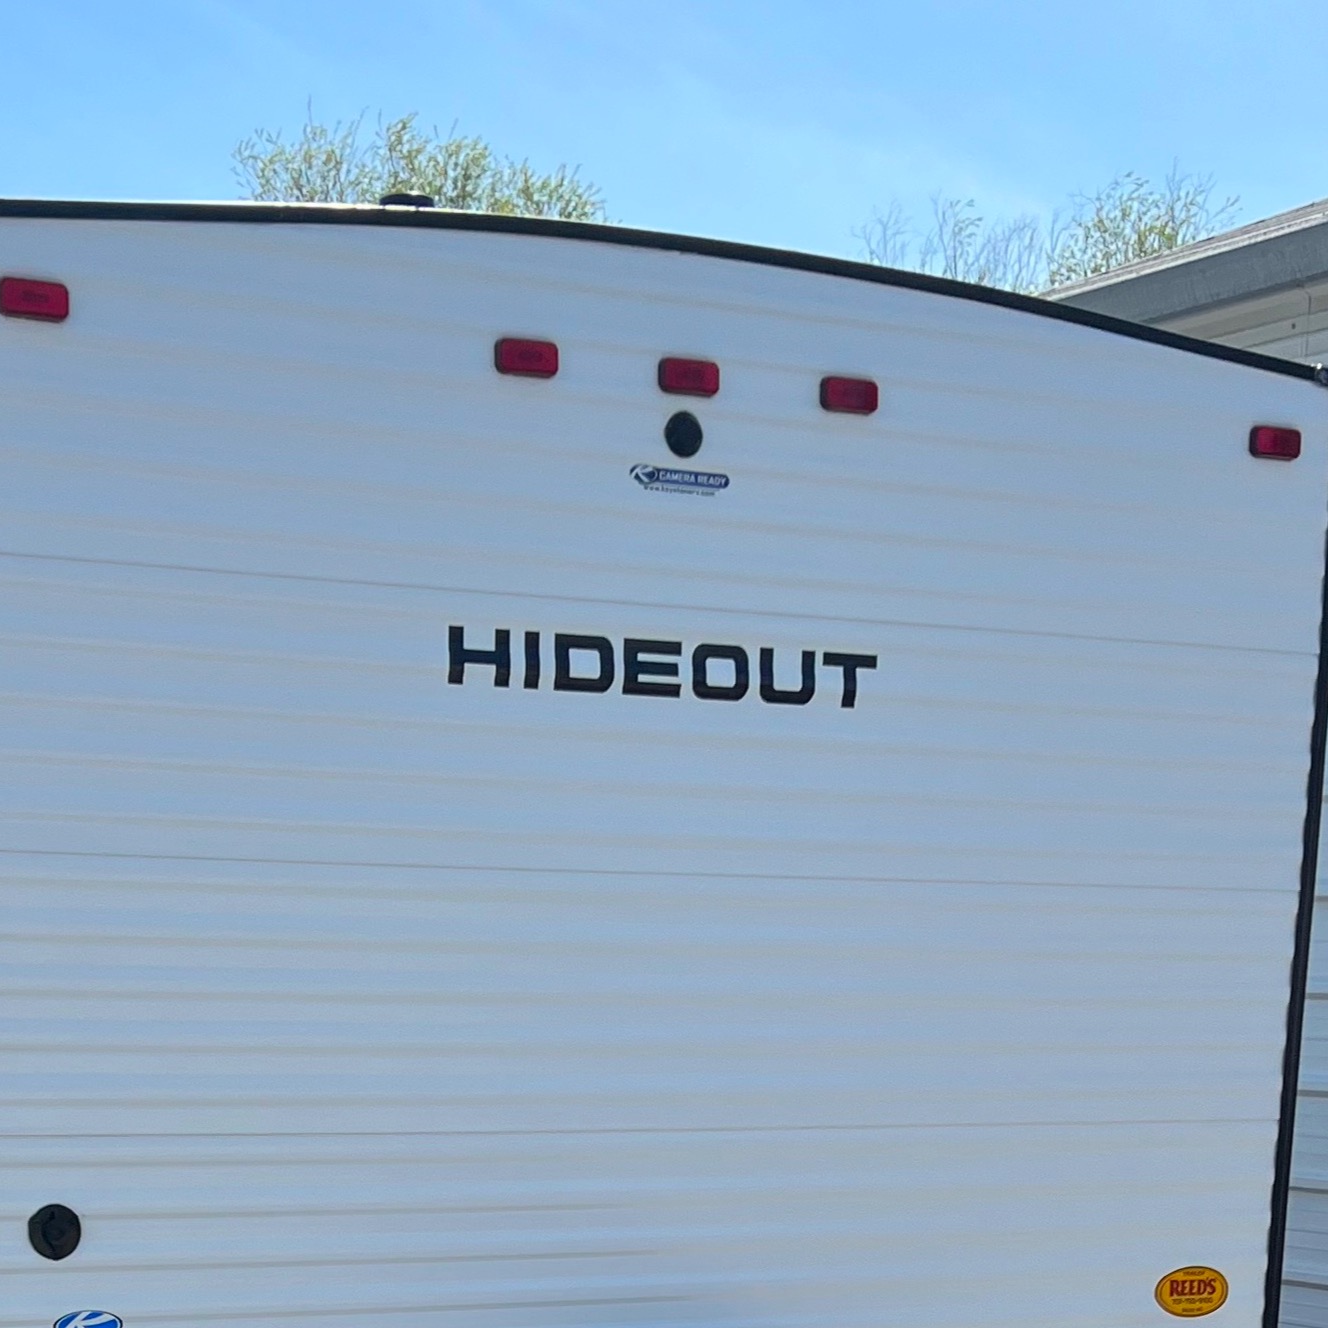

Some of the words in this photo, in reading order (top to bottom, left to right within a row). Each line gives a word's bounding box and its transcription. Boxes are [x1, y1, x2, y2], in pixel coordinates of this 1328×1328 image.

[659, 470, 695, 483] CAMERA
[697, 475, 727, 486] READY
[447, 625, 878, 709] HIDEOUT
[1169, 1277, 1217, 1297] REED'S
